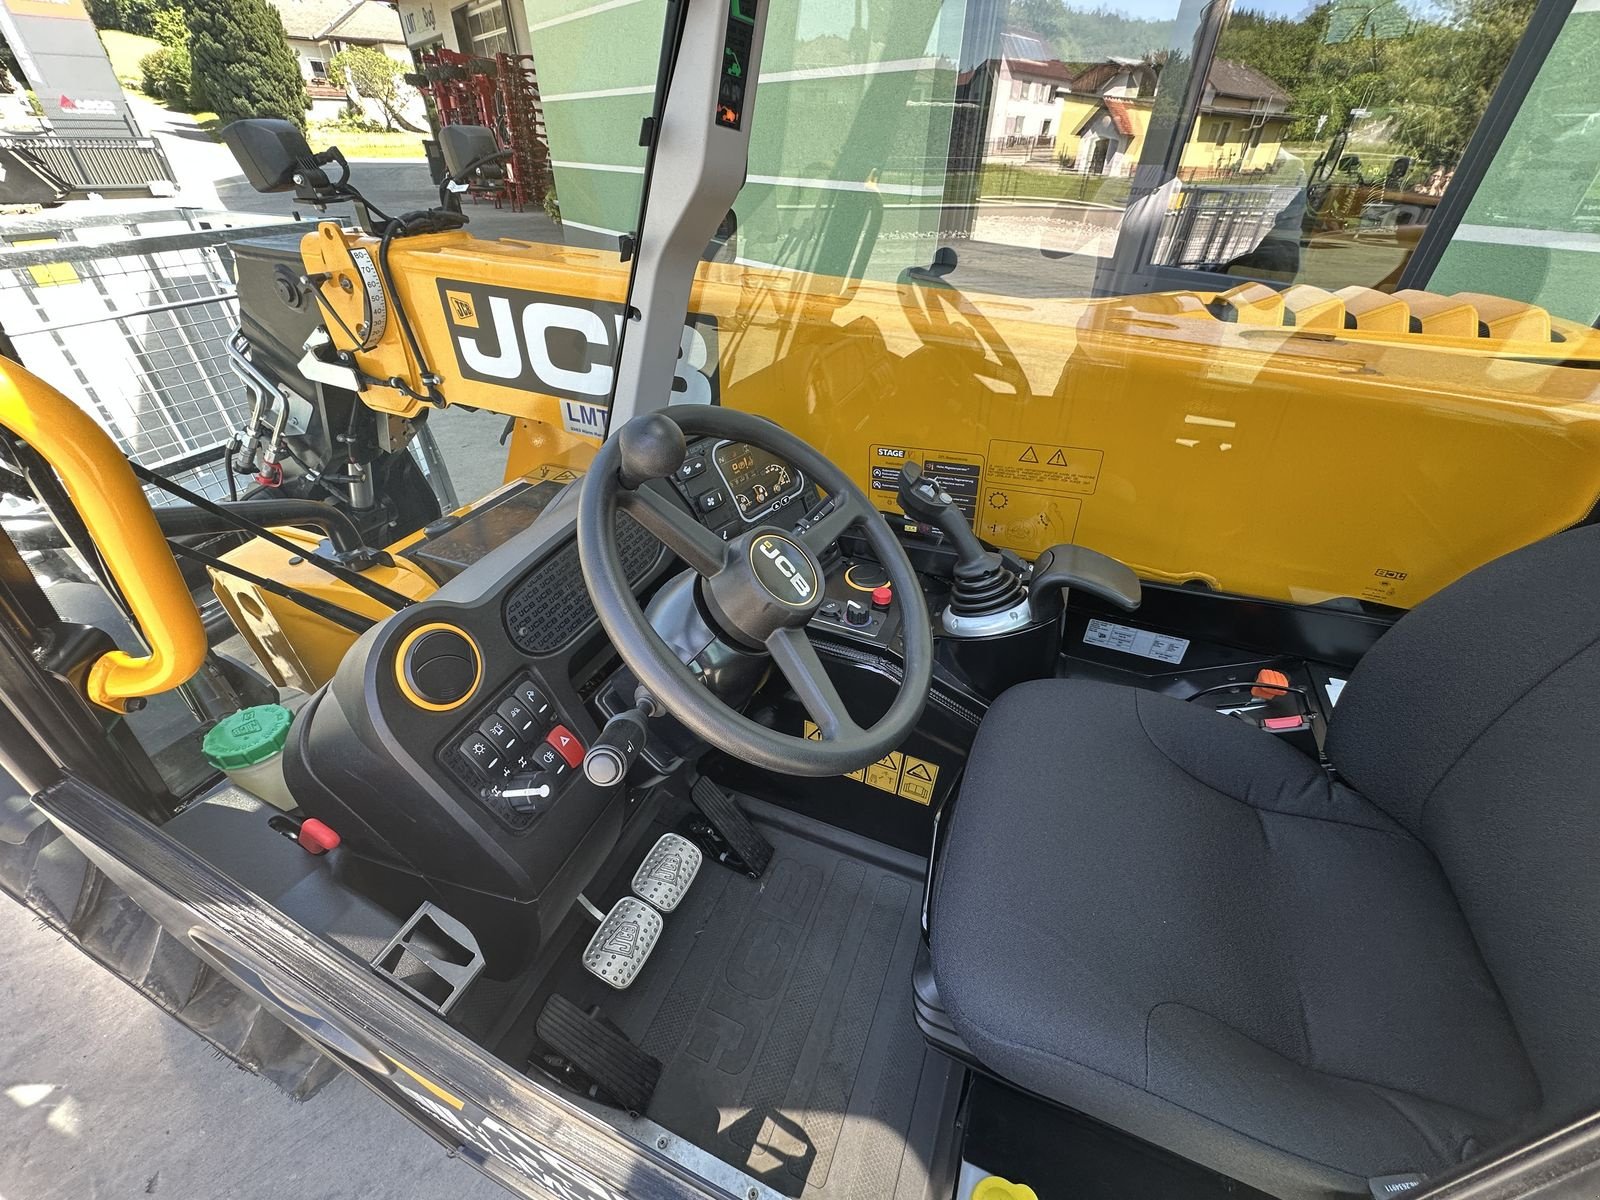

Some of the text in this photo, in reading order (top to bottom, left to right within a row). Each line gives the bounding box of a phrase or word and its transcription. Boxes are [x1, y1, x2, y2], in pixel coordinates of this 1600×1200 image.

[353, 251, 364, 259] 80
[361, 266, 371, 274] 70
[371, 294, 380, 302] 50
[567, 402, 608, 427] LMT
[878, 448, 904, 458] STAGE
[759, 544, 811, 598] JCB
